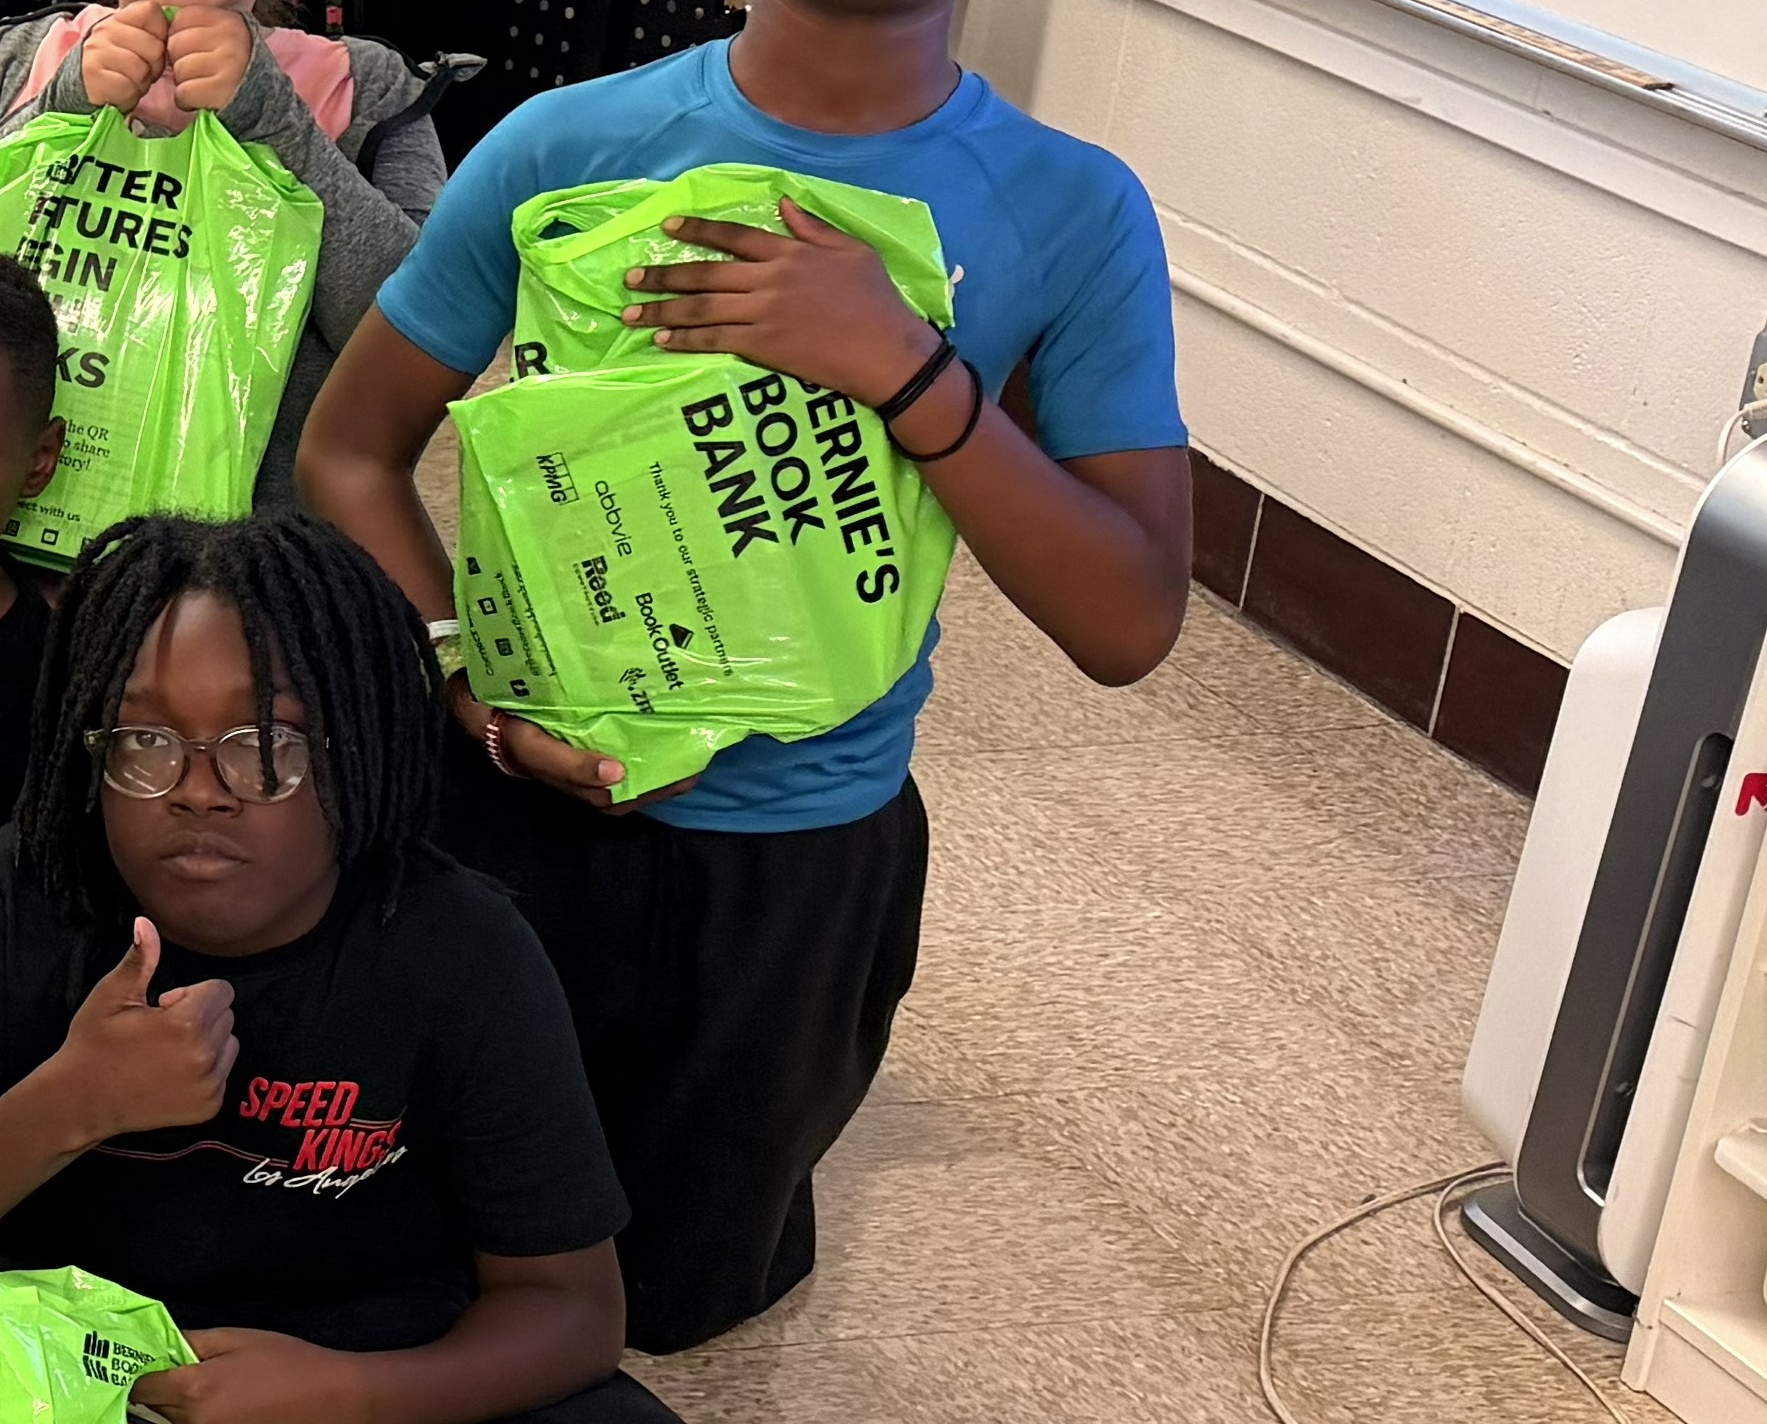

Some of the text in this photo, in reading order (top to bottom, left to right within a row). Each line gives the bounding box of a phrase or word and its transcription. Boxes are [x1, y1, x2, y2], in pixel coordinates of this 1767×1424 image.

[681, 392, 779, 559] BANK
[740, 372, 827, 546] BOOK
[241, 1077, 359, 1128] SPEED
